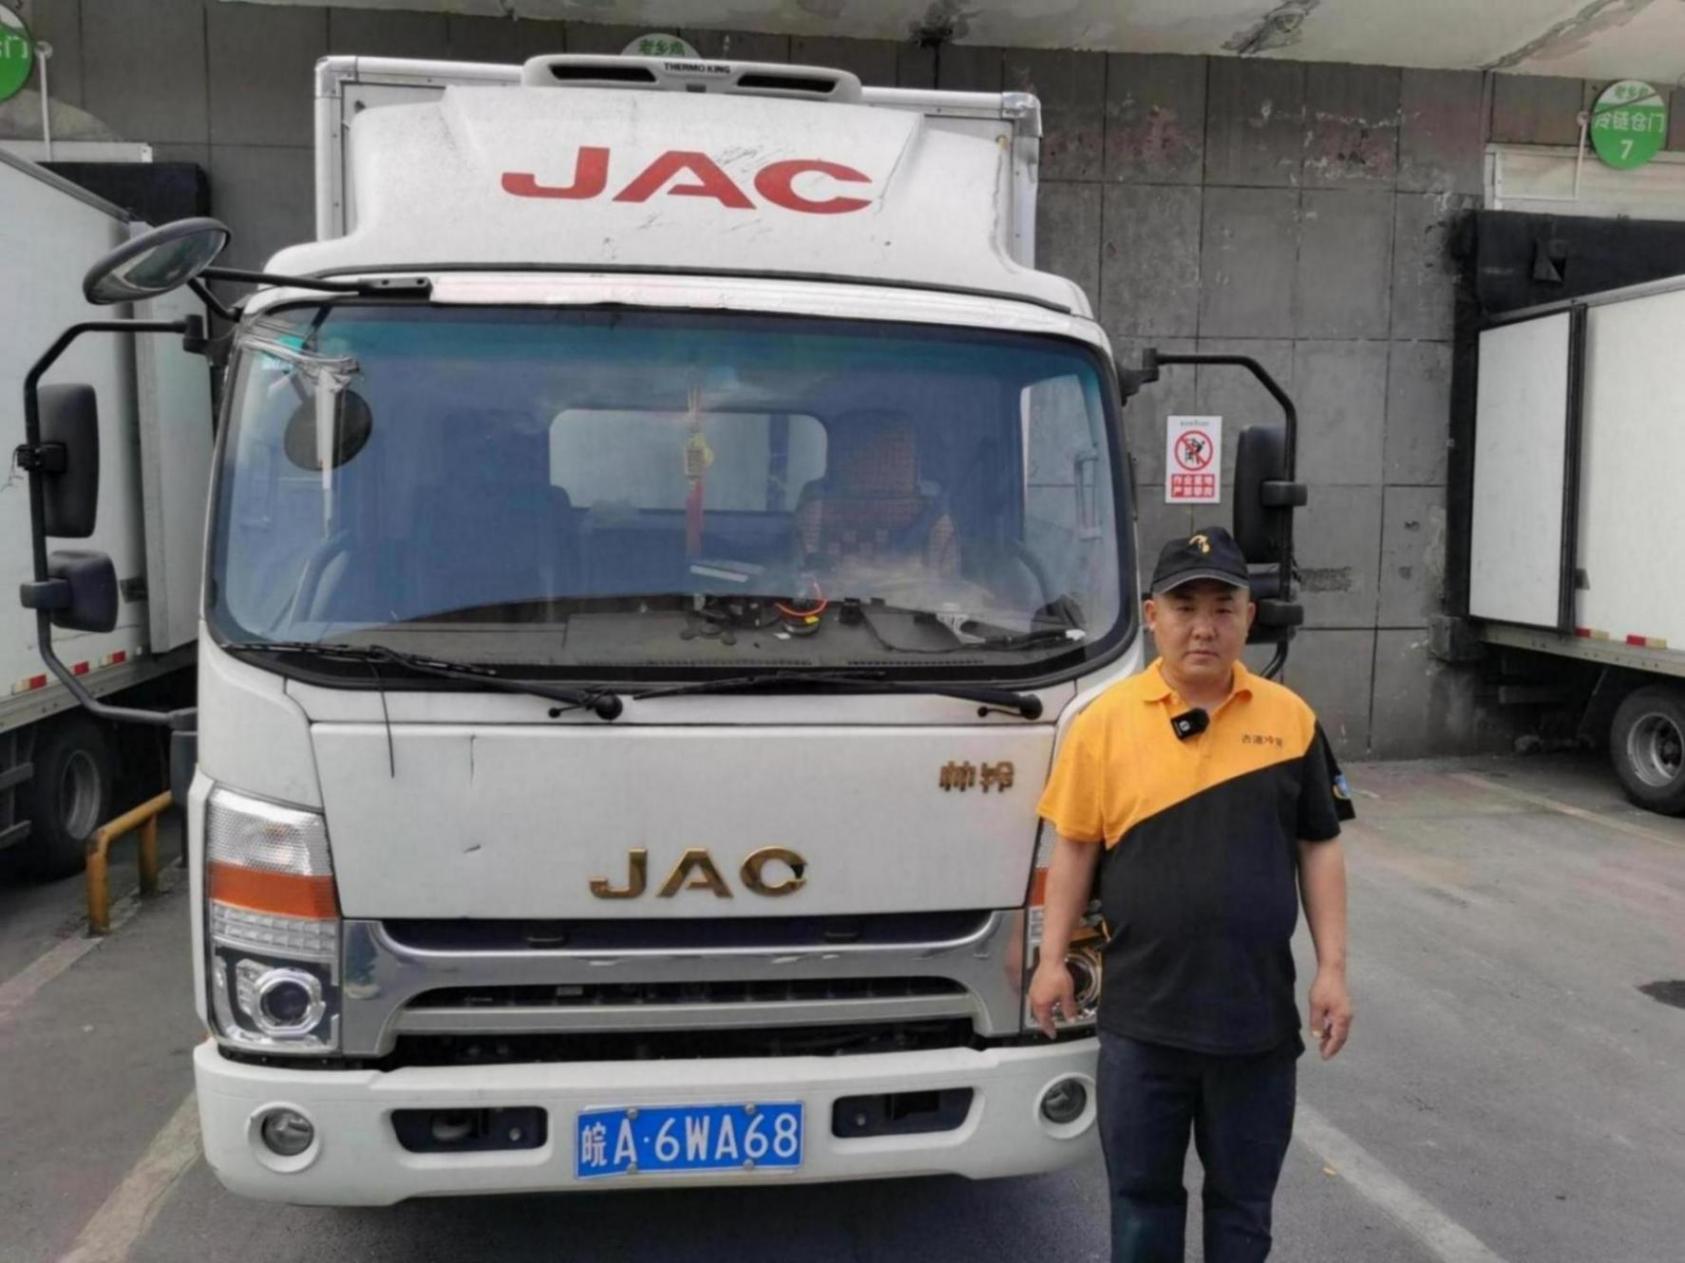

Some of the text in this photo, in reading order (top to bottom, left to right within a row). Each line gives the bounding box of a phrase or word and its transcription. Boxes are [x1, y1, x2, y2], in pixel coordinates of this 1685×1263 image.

[664, 62, 731, 74] THERMO KING
[1594, 110, 1665, 133] 冷链仓门
[1620, 139, 1634, 160] 7
[501, 146, 873, 214] JAC
[588, 845, 808, 899] JAC
